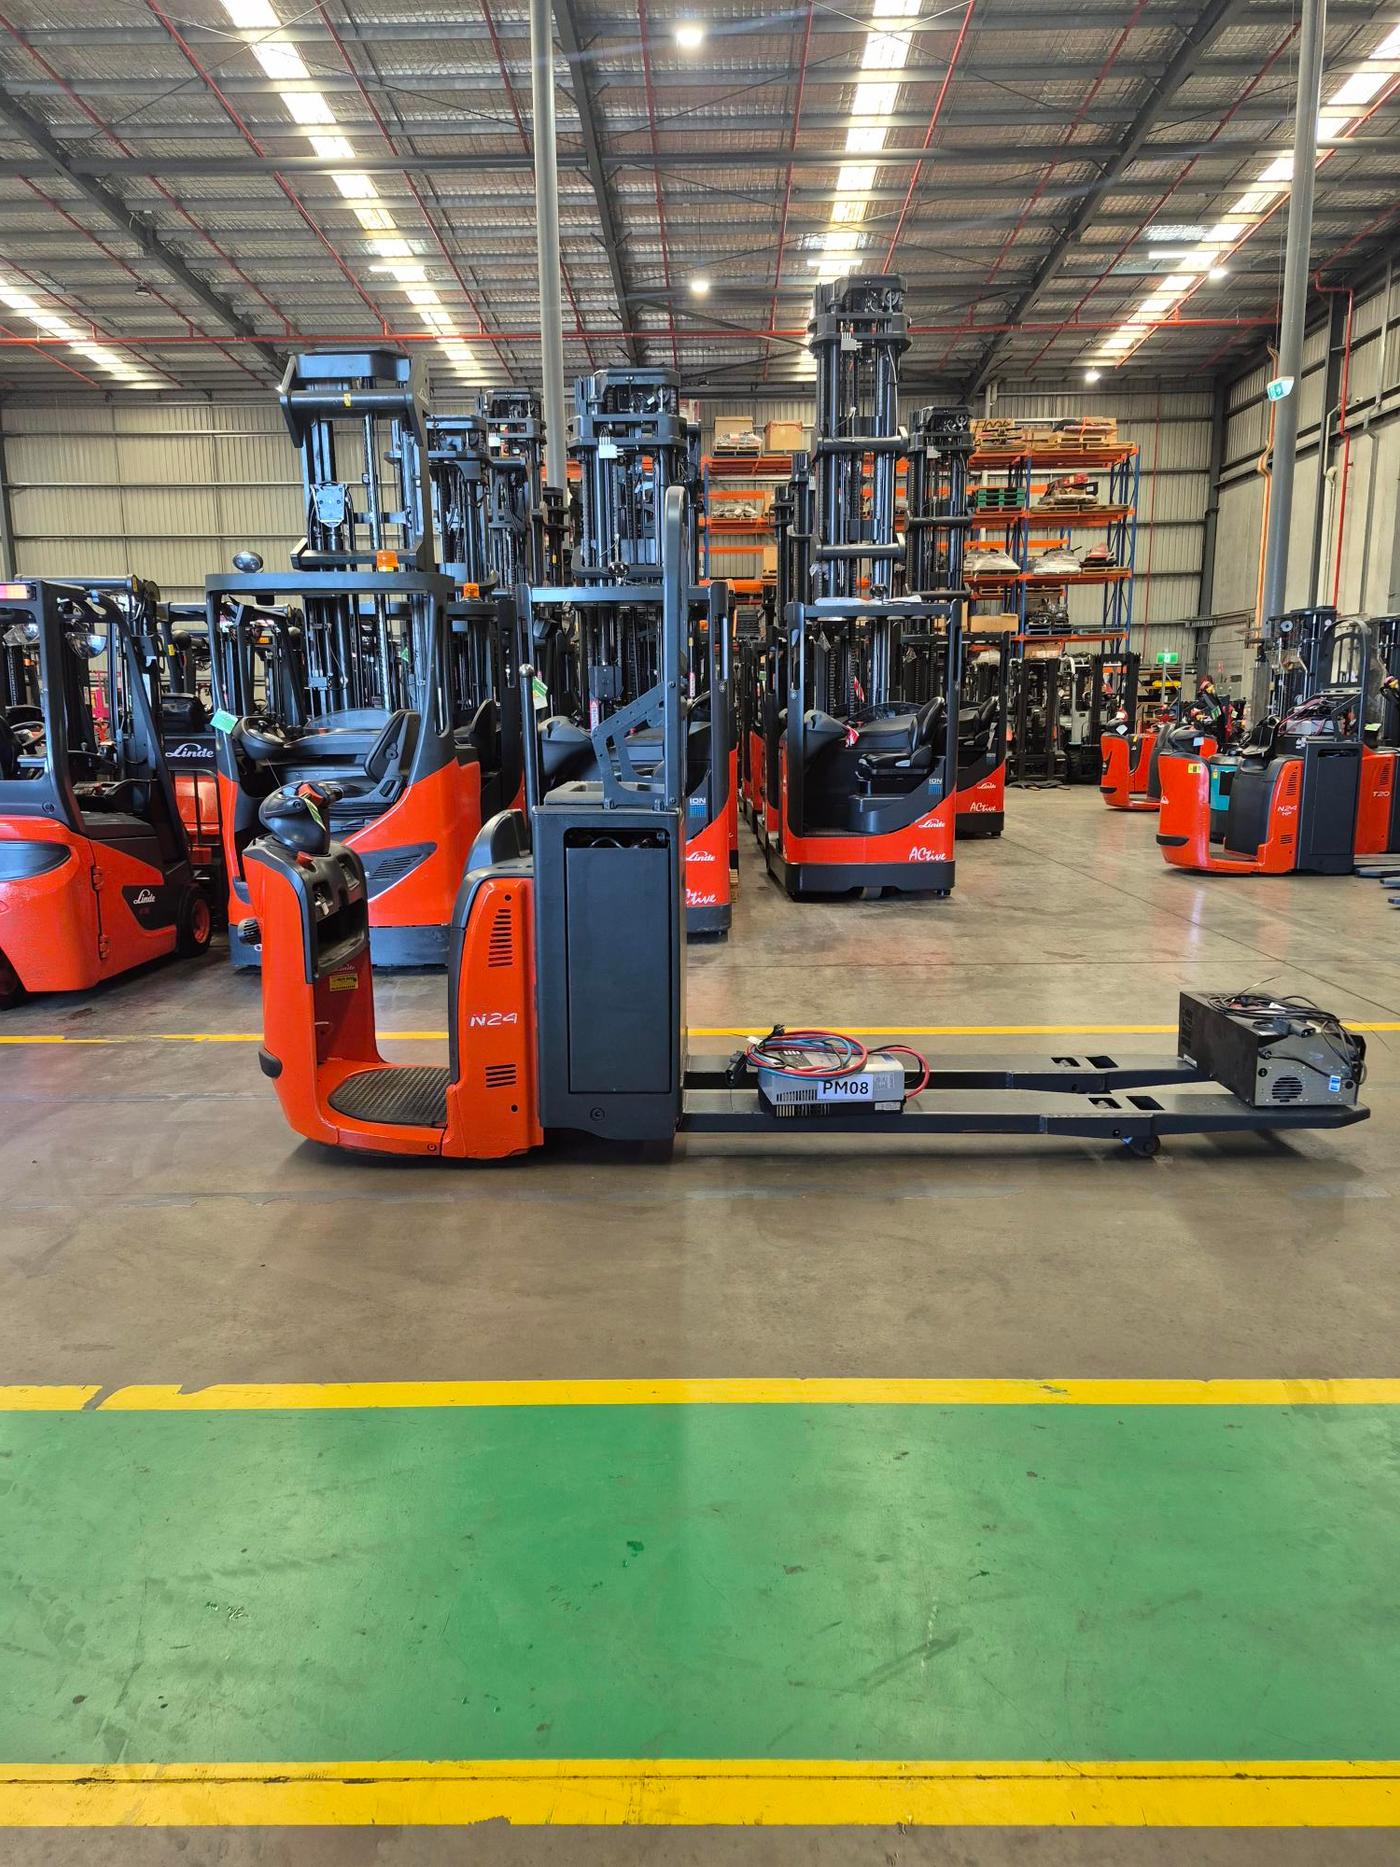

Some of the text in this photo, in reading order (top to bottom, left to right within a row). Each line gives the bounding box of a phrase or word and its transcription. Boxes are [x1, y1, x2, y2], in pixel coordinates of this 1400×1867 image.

[165, 743, 214, 758] Linde
[689, 797, 707, 805] ION
[918, 819, 945, 829] Linde
[686, 850, 716, 862] Linde
[470, 1012, 518, 1027] N24
[822, 1081, 869, 1095] PM08
